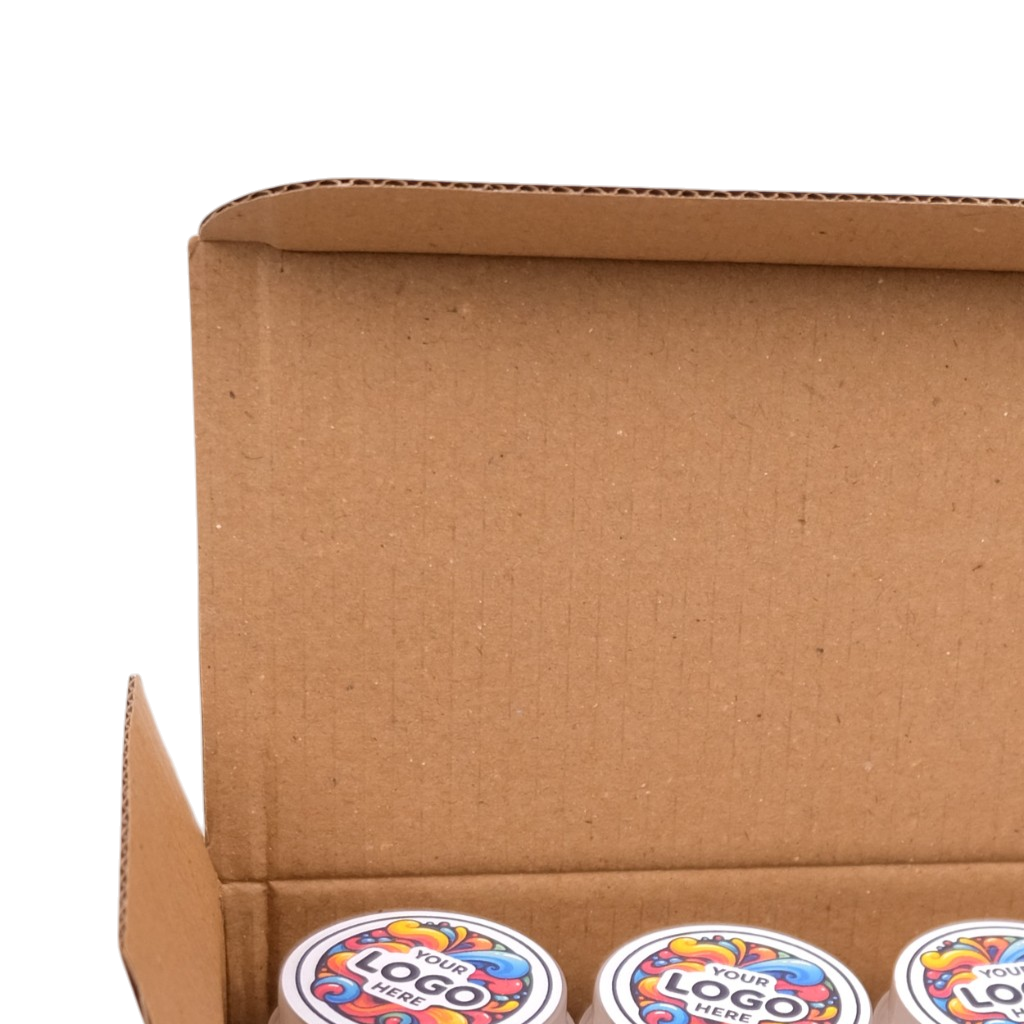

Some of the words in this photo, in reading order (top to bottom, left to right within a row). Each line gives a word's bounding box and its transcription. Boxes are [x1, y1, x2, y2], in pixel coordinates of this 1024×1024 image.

[414, 949, 468, 976] YOUR
[355, 951, 485, 1006] LOGO
[712, 965, 770, 988] YOUR
[370, 981, 426, 1008] HERE
[664, 972, 802, 1018] LOGO
[694, 1002, 752, 1024] HERE
